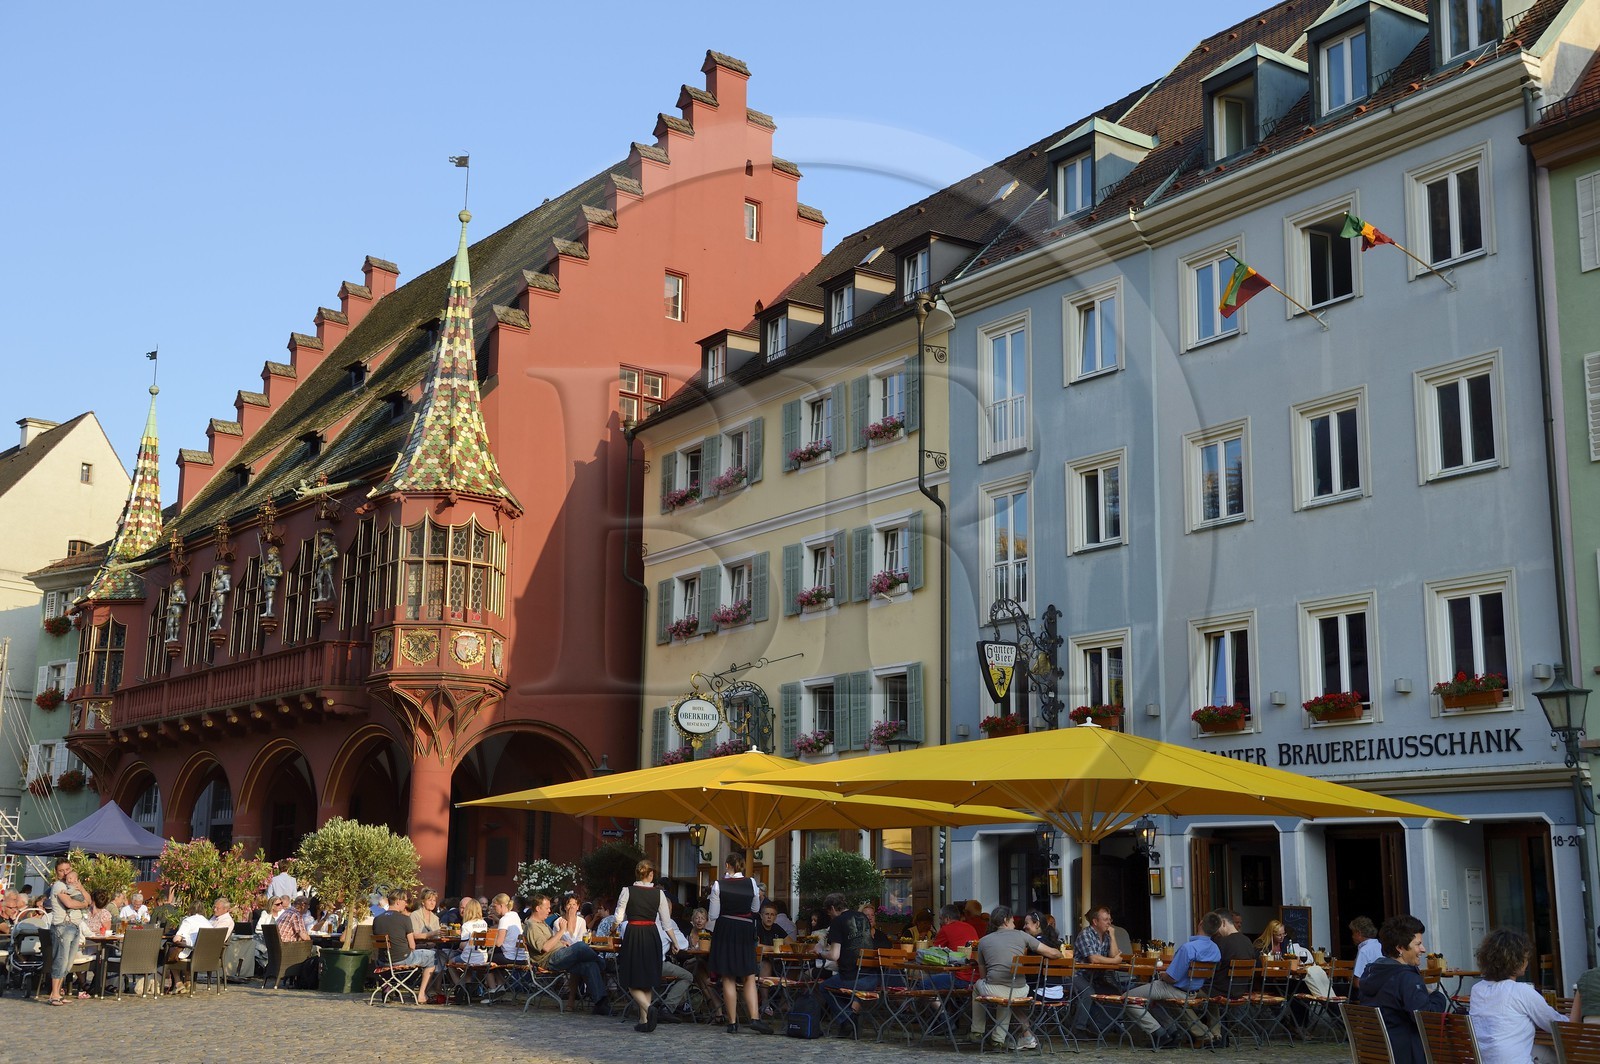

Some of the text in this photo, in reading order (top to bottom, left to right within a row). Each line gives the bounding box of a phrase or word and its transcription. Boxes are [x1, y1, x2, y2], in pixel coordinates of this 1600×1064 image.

[679, 712, 717, 721] OBERKIRCH
[1201, 728, 1524, 767] TER BRAUEREIAUSSCHANK
[1552, 834, 1580, 847] 18-20
